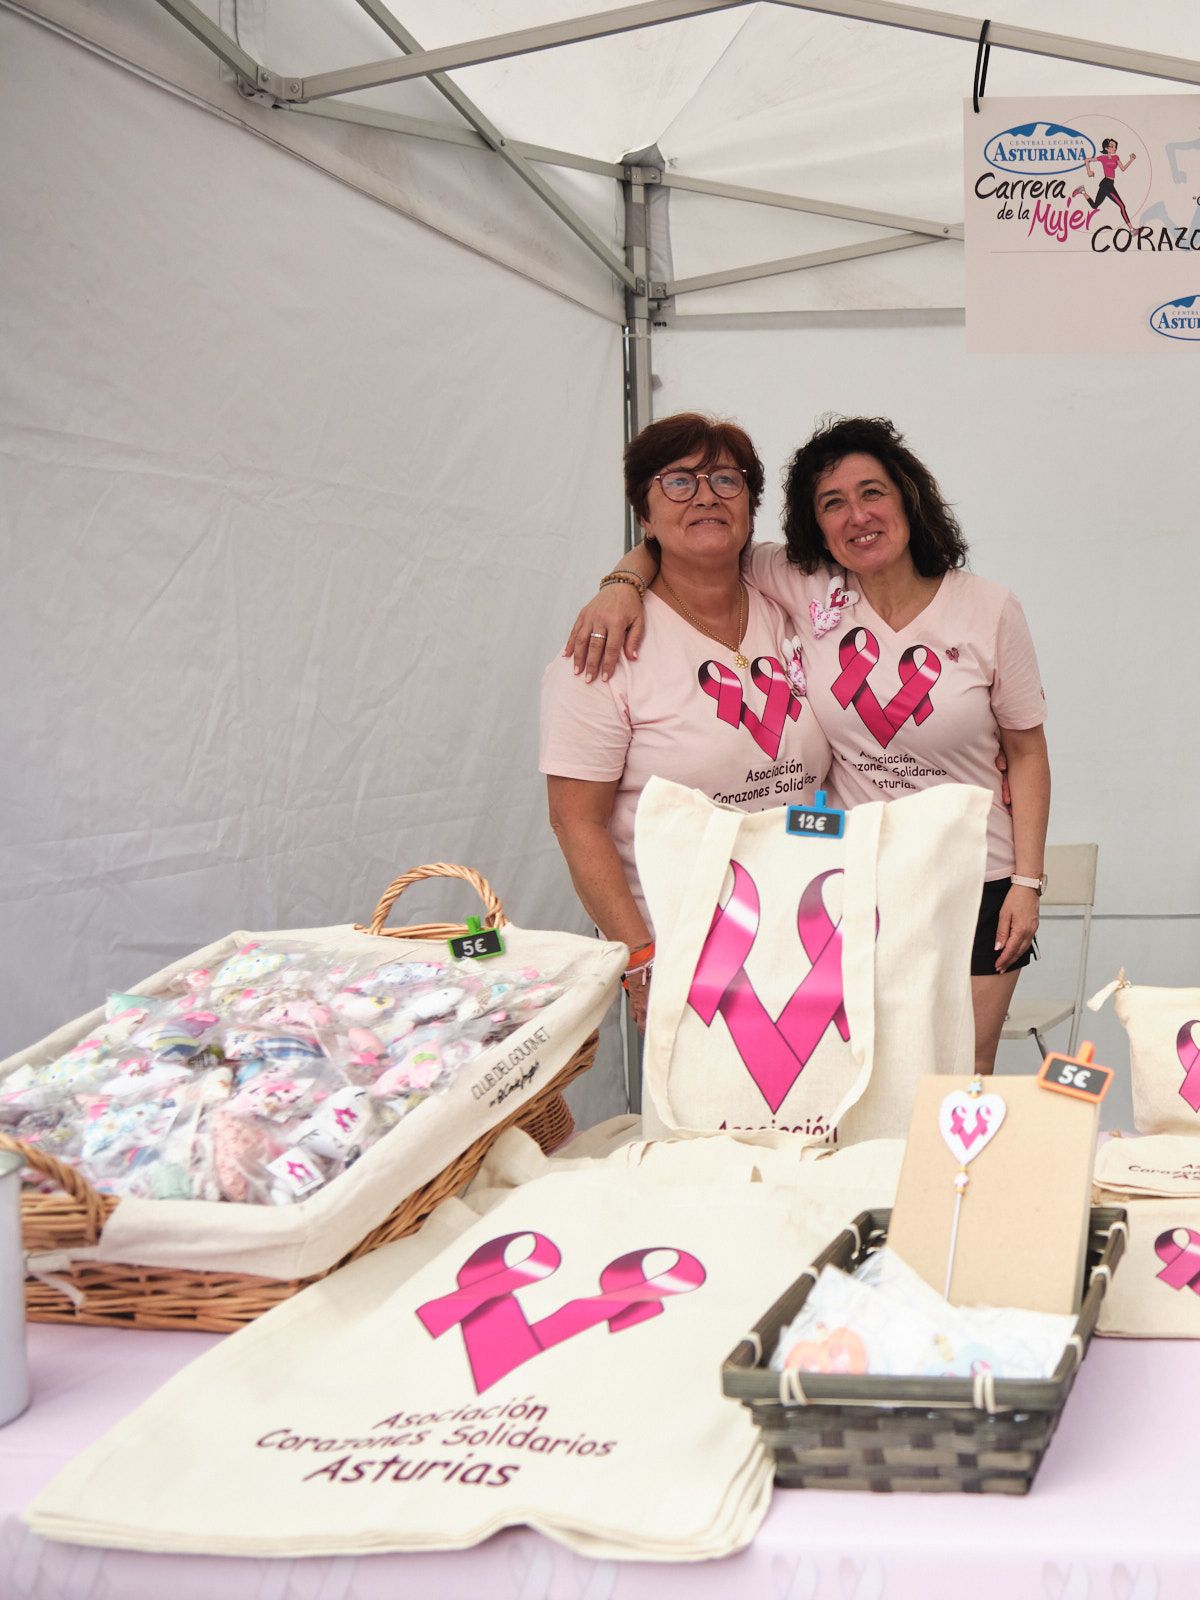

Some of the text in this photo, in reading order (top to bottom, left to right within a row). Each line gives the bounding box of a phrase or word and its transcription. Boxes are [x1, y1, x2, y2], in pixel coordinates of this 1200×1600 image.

[993, 142, 1087, 161] ASTURIANA
[975, 172, 1066, 199] Carrera
[997, 197, 1100, 242] de la Mujer
[745, 759, 803, 783] Asociación
[798, 813, 827, 832] 12€
[462, 938, 488, 956] 5€
[1057, 1064, 1092, 1088] 5€
[371, 1395, 549, 1430] Asociación
[254, 1422, 618, 1457] Corazones Solidarios
[301, 1452, 520, 1488] Asturias
